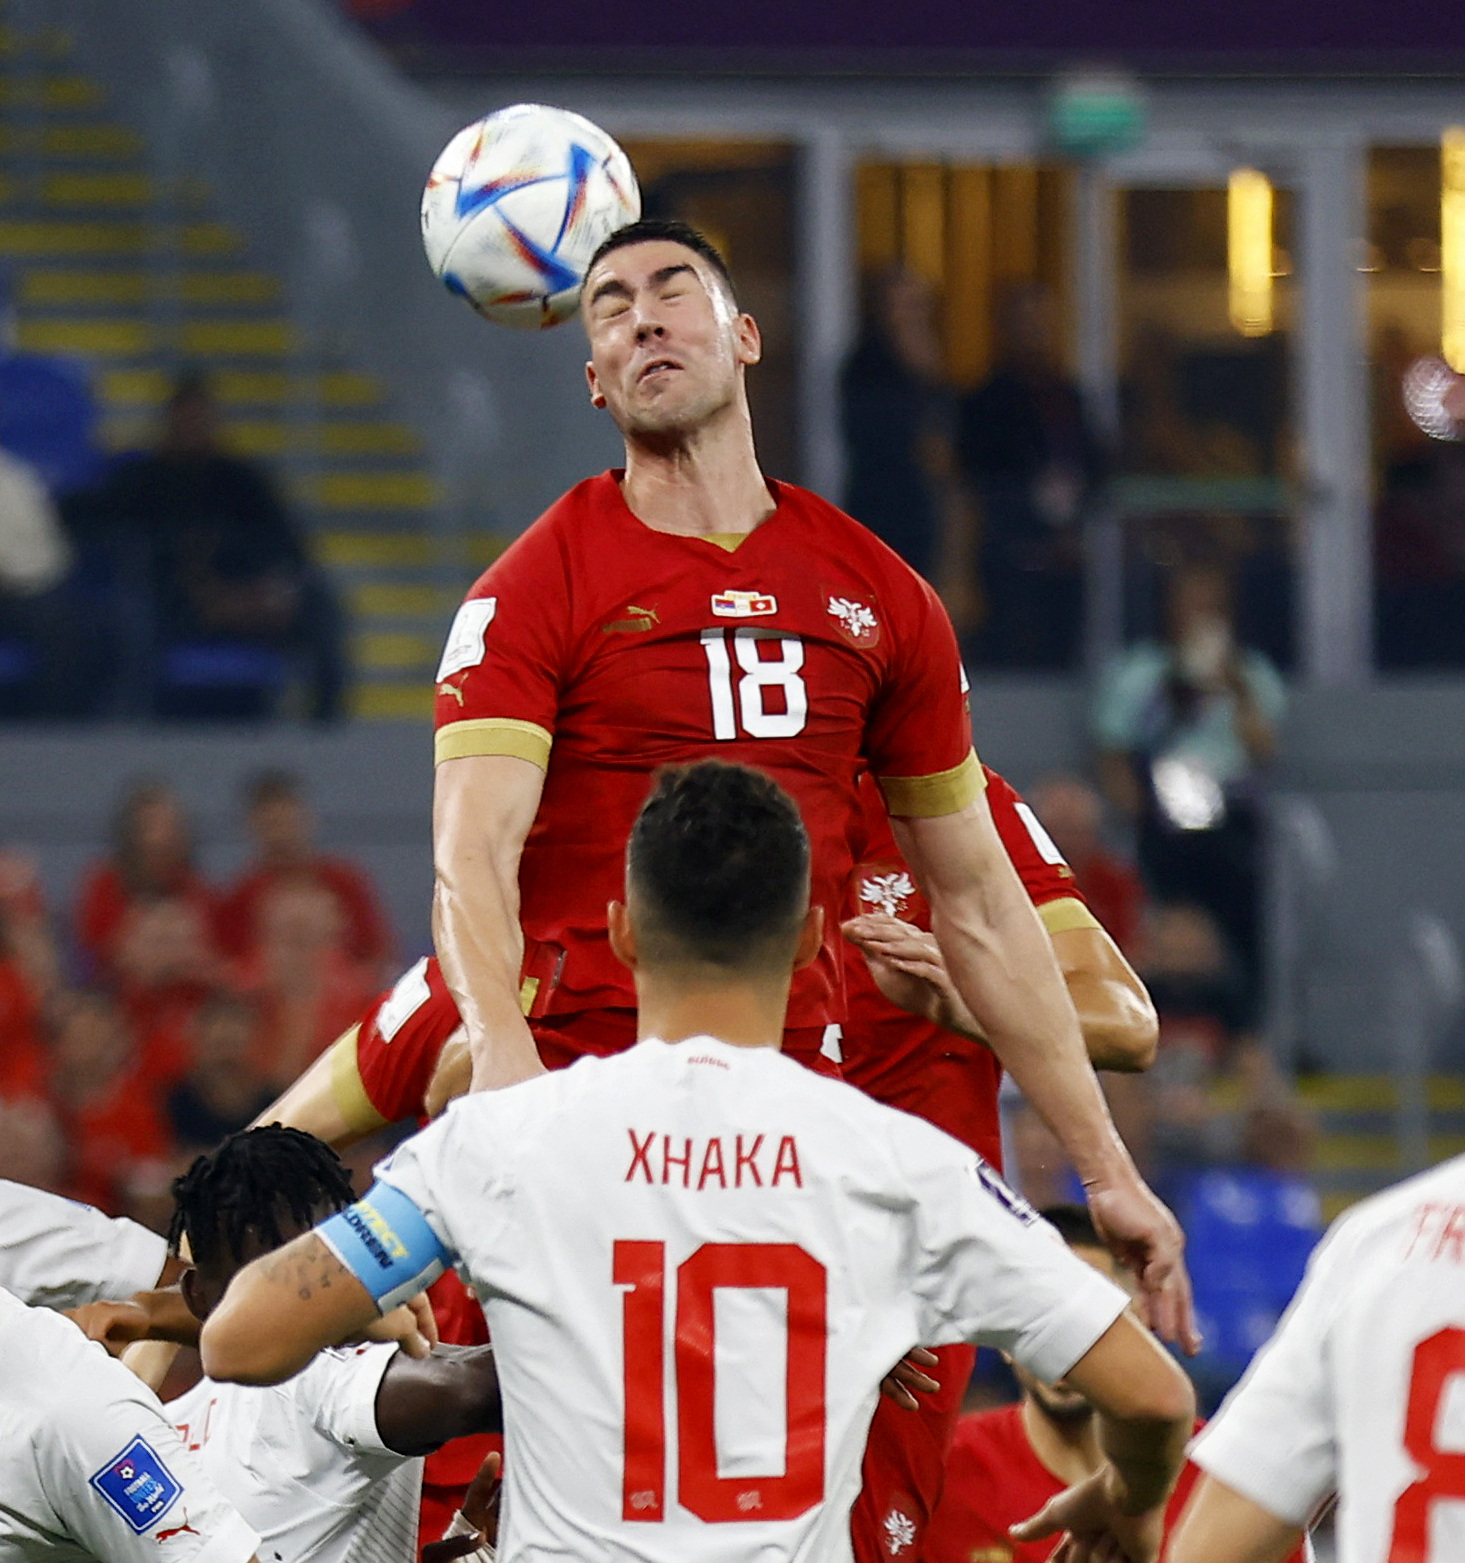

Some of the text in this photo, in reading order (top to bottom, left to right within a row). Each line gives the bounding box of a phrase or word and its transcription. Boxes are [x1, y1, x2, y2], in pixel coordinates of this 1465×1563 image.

[700, 627, 808, 741] 18
[624, 1128, 804, 1191] XHAKA
[612, 1239, 827, 1523] 10
